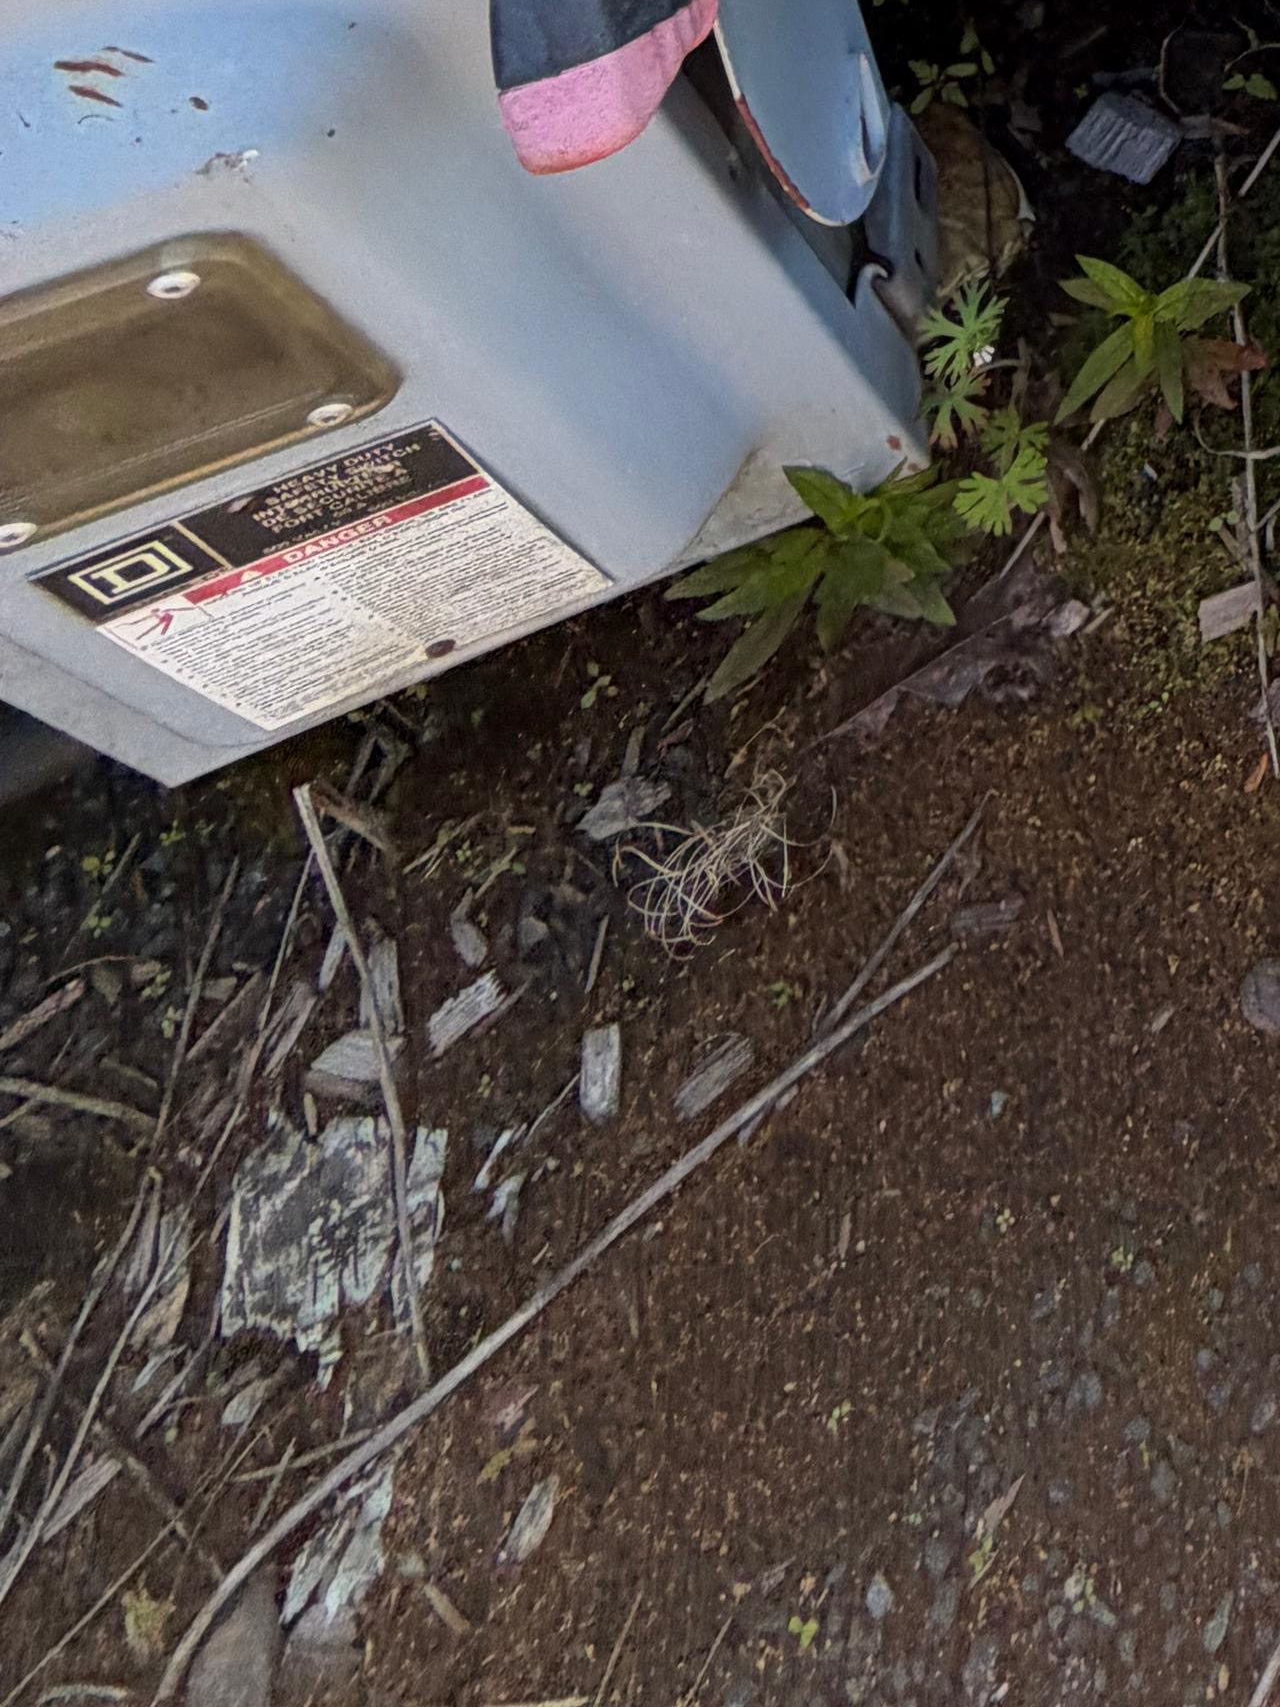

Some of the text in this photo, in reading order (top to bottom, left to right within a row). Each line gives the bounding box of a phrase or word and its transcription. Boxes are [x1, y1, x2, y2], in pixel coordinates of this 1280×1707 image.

[271, 442, 396, 494] HEAVY DUTY
[284, 516, 391, 563] DANGER
